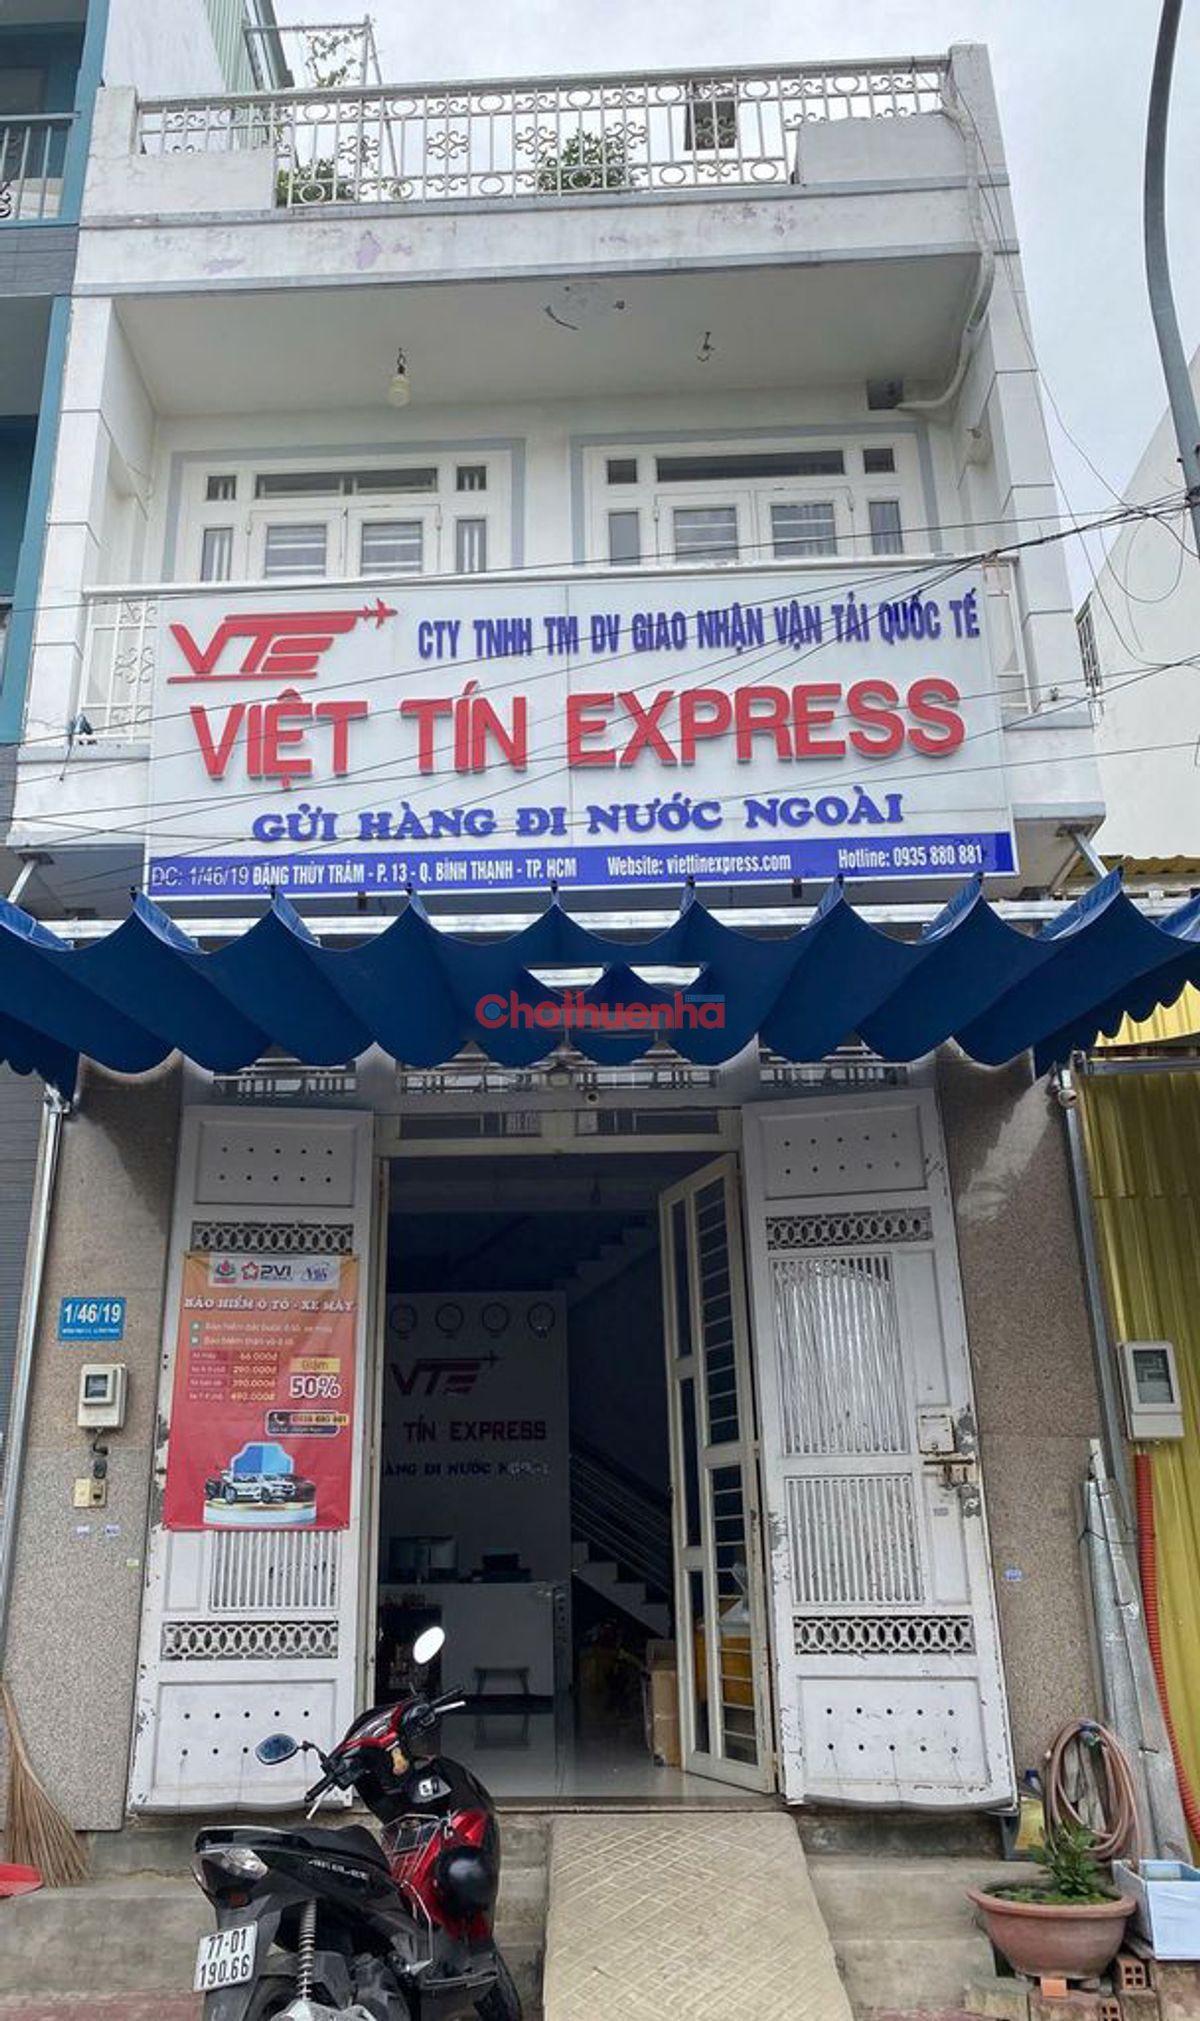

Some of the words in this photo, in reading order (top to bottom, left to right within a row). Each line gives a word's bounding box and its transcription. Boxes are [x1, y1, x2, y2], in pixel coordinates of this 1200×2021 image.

[169, 609, 358, 676] VTE
[418, 620, 462, 659] CTY
[473, 618, 532, 659] TNHH
[544, 615, 579, 656] TM
[591, 613, 621, 654] DV
[632, 611, 687, 652] GIAO
[697, 602, 766, 655] NHẬN
[774, 599, 823, 650] VẬN
[831, 591, 871, 643] TẢI
[879, 589, 942, 646] QUỐC
[949, 587, 981, 640] TẾ
[189, 687, 369, 791] VIỆT
[400, 680, 528, 775] TÍN
[565, 677, 967, 770] EXPRESS
[252, 803, 338, 843] GỬI
[358, 801, 498, 842] HÀNG
[516, 805, 568, 838] ĐI
[586, 792, 724, 835] NƯỚC
[745, 785, 905, 830] NGOÀI
[151, 866, 184, 887] ĐC:
[189, 865, 249, 887] 1/46/19
[376, 863, 388, 883] P.
[392, 862, 408, 882] 13
[419, 862, 432, 884] Q.
[470, 859, 513, 885] THẠNH
[525, 858, 544, 879] TP.
[547, 857, 577, 878] HCM
[607, 855, 664, 876] Website:
[667, 853, 791, 874] viettinexpress.com
[838, 848, 891, 869] Hotline:
[893, 846, 928, 867] 0935
[930, 845, 956, 866] 880
[958, 844, 983, 864] 881
[261, 1264, 292, 1277] PVI
[64, 1303, 122, 1324] 1/46/19
[289, 1375, 342, 1399] 50%
[403, 1413, 436, 1443] TÍN
[450, 1420, 547, 1441] EXPRESS
[200, 1953, 251, 1988] 190.66
